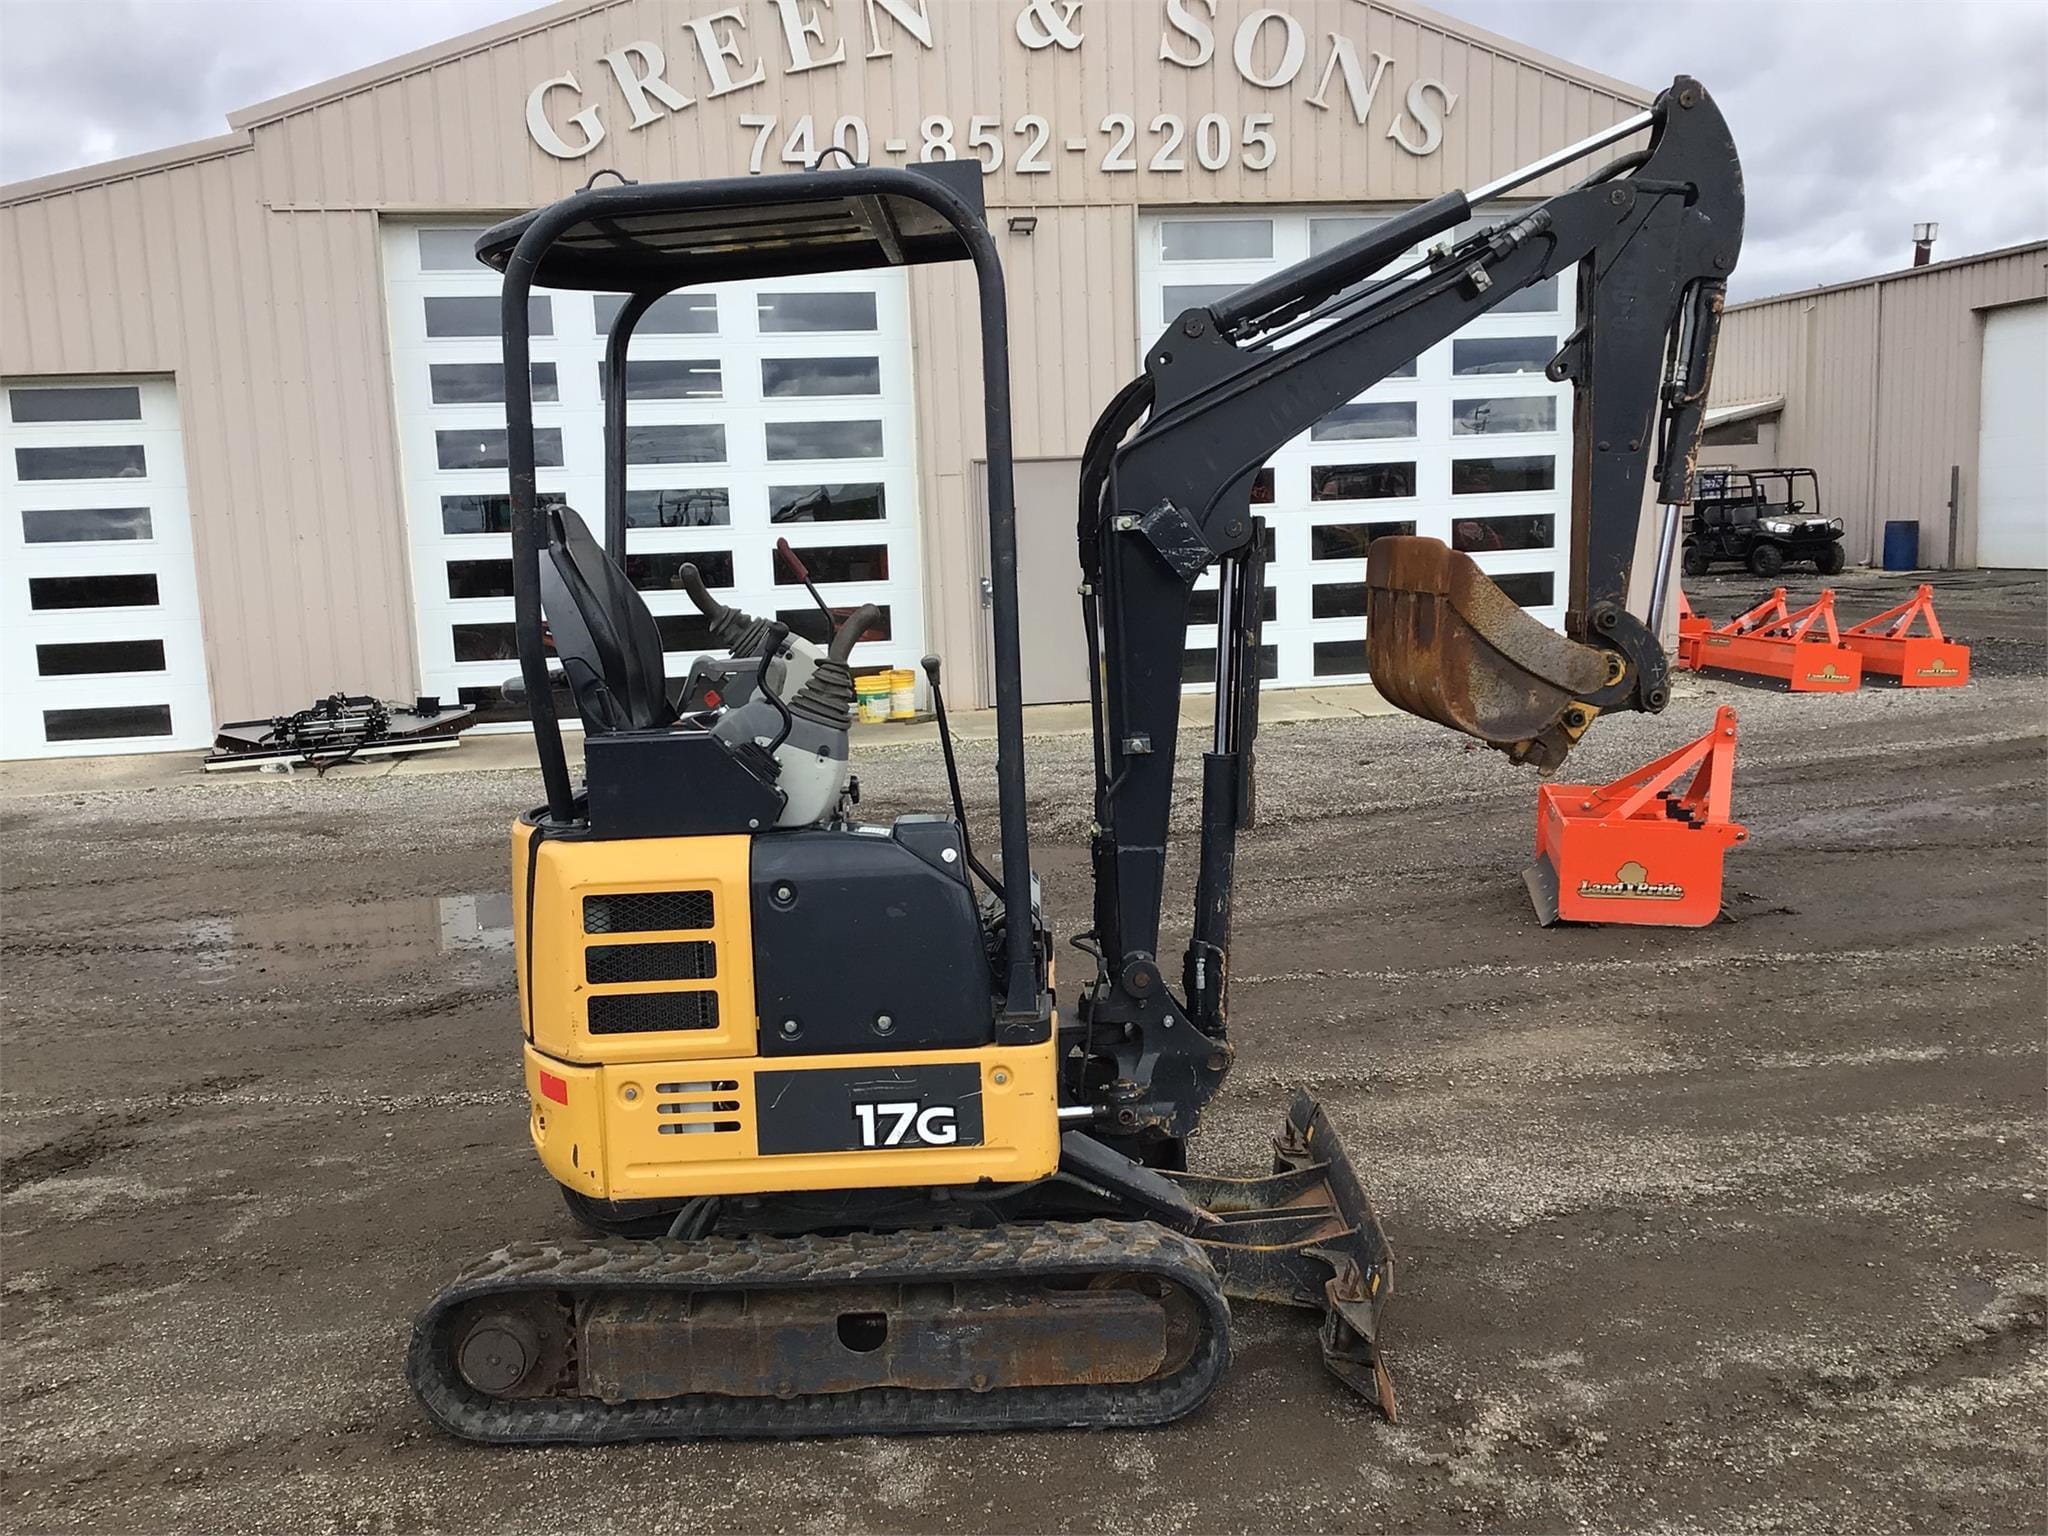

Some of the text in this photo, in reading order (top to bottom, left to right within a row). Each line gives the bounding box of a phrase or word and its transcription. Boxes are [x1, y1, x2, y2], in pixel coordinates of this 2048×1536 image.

[524, 0, 1459, 160] GREEN & SONS
[738, 113, 1278, 174] 740-852-2205
[1580, 879, 1684, 897] Land Pride
[855, 1102, 957, 1146] 17G
